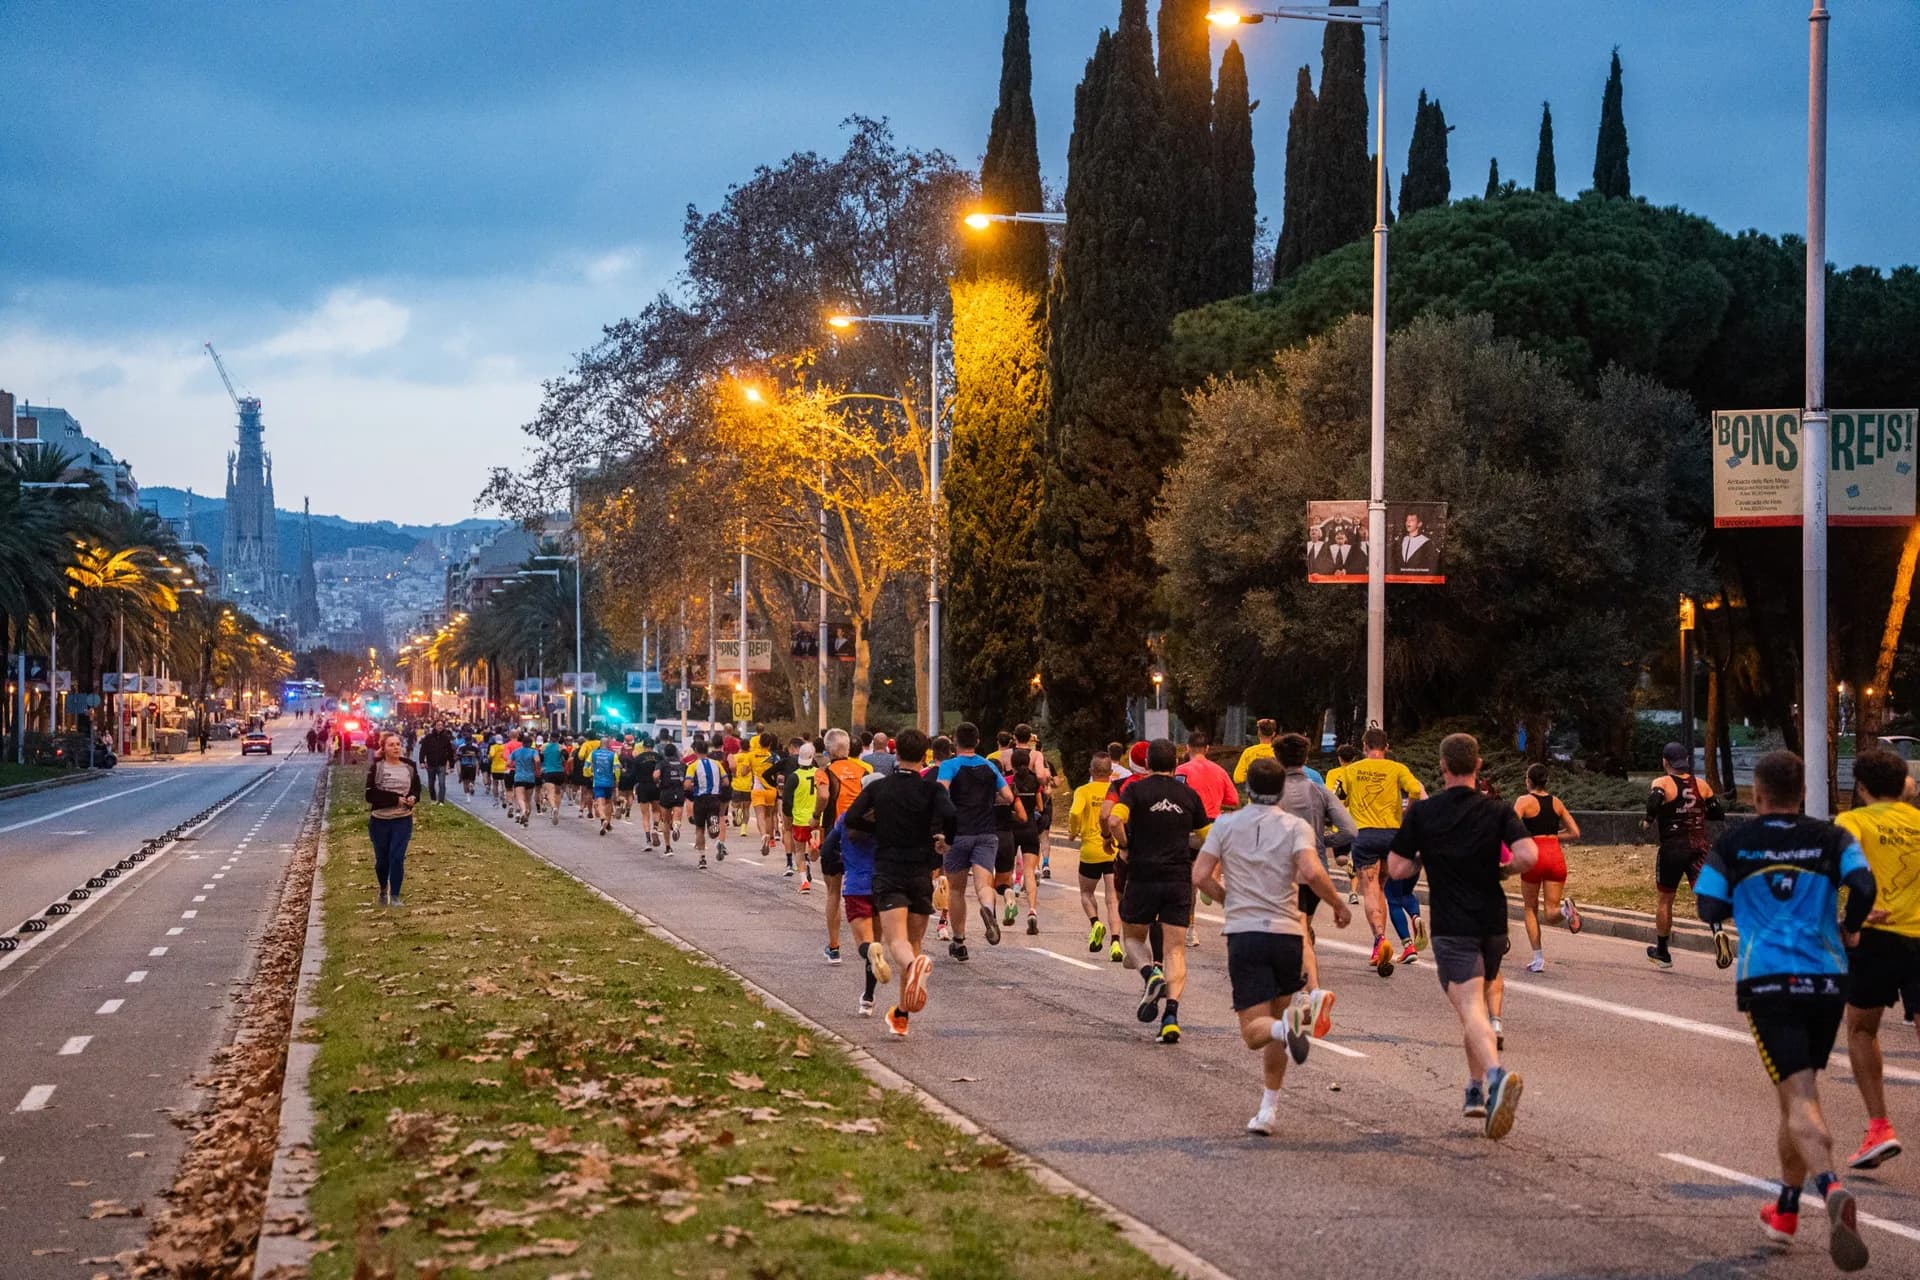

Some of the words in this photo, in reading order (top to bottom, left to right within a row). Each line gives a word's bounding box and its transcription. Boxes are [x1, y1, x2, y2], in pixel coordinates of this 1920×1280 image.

[1718, 415, 1799, 471] BONS
[1831, 414, 1913, 471] REIS!
[679, 691, 688, 702] P
[734, 702, 752, 717] 05
